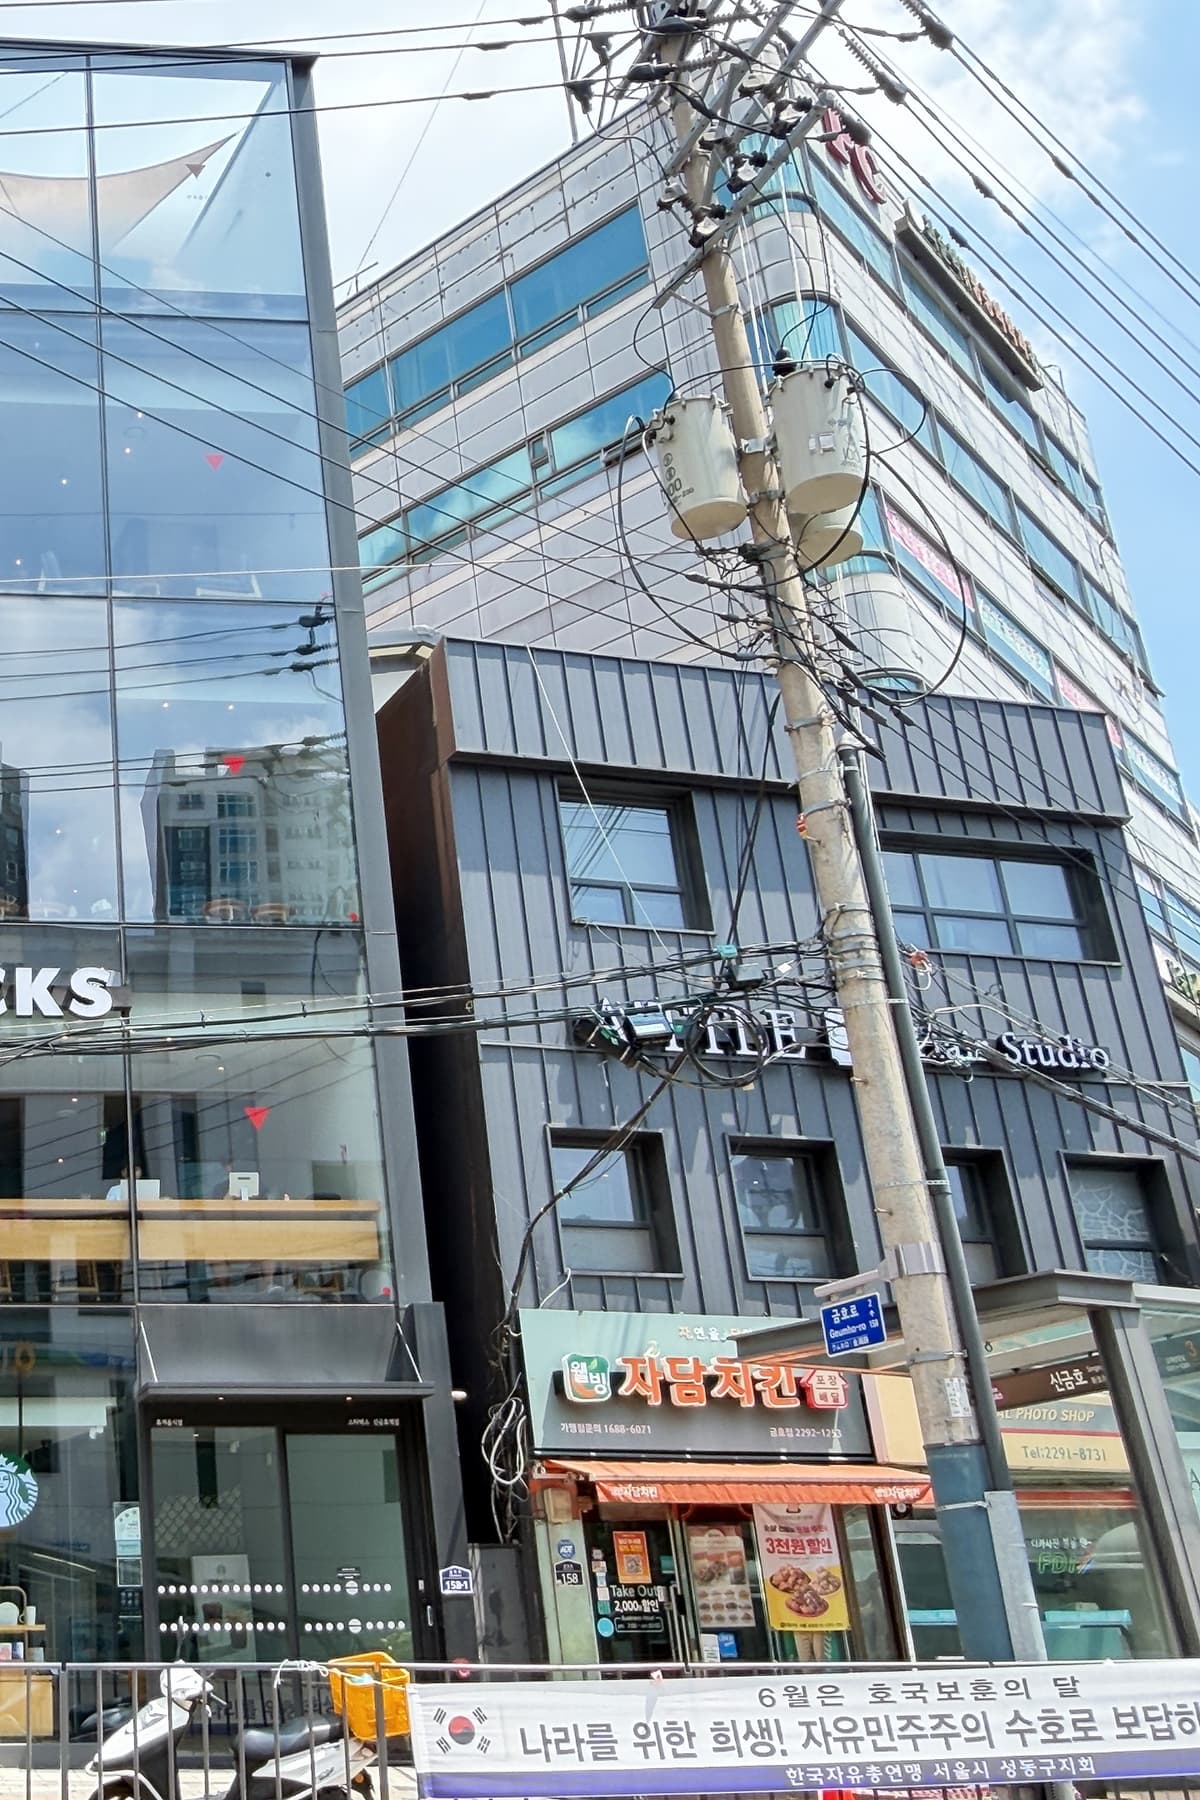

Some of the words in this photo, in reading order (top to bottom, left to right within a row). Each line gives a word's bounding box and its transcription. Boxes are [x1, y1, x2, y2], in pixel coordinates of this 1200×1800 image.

[1000, 1031, 1110, 1068] Studio
[831, 1304, 860, 1324] 금호로
[570, 1361, 607, 1395] 웰빙
[615, 1355, 800, 1409] 자담치킨
[816, 1375, 837, 1386] 포장
[1050, 1368, 1089, 1392] 신금호
[1015, 1408, 1057, 1421] PHOTO
[1061, 1410, 1095, 1422] SHOP
[604, 1424, 652, 1434] 1688-6071
[1022, 1446, 1107, 1461] Tel:2291-8731
[765, 1537, 806, 1555] 3천원
[806, 1538, 833, 1554] 할인
[561, 1573, 579, 1585] 158
[610, 1584, 635, 1597] Take
[758, 1683, 845, 1708] 6월은
[868, 1677, 1032, 1705] 호국보훈의
[1052, 1675, 1081, 1698] 달
[520, 1723, 619, 1763] 나라를
[633, 1720, 698, 1761] 위한
[710, 1718, 788, 1759] 희생!
[798, 1710, 996, 1756] 자유민주주의
[1005, 1707, 1104, 1748] 수호로
[1112, 1701, 1200, 1741] 보답하
[785, 1763, 922, 1787] 한국자유총연맹
[933, 1759, 991, 1781] 서울시
[1000, 1756, 1096, 1779] 성동구지회
